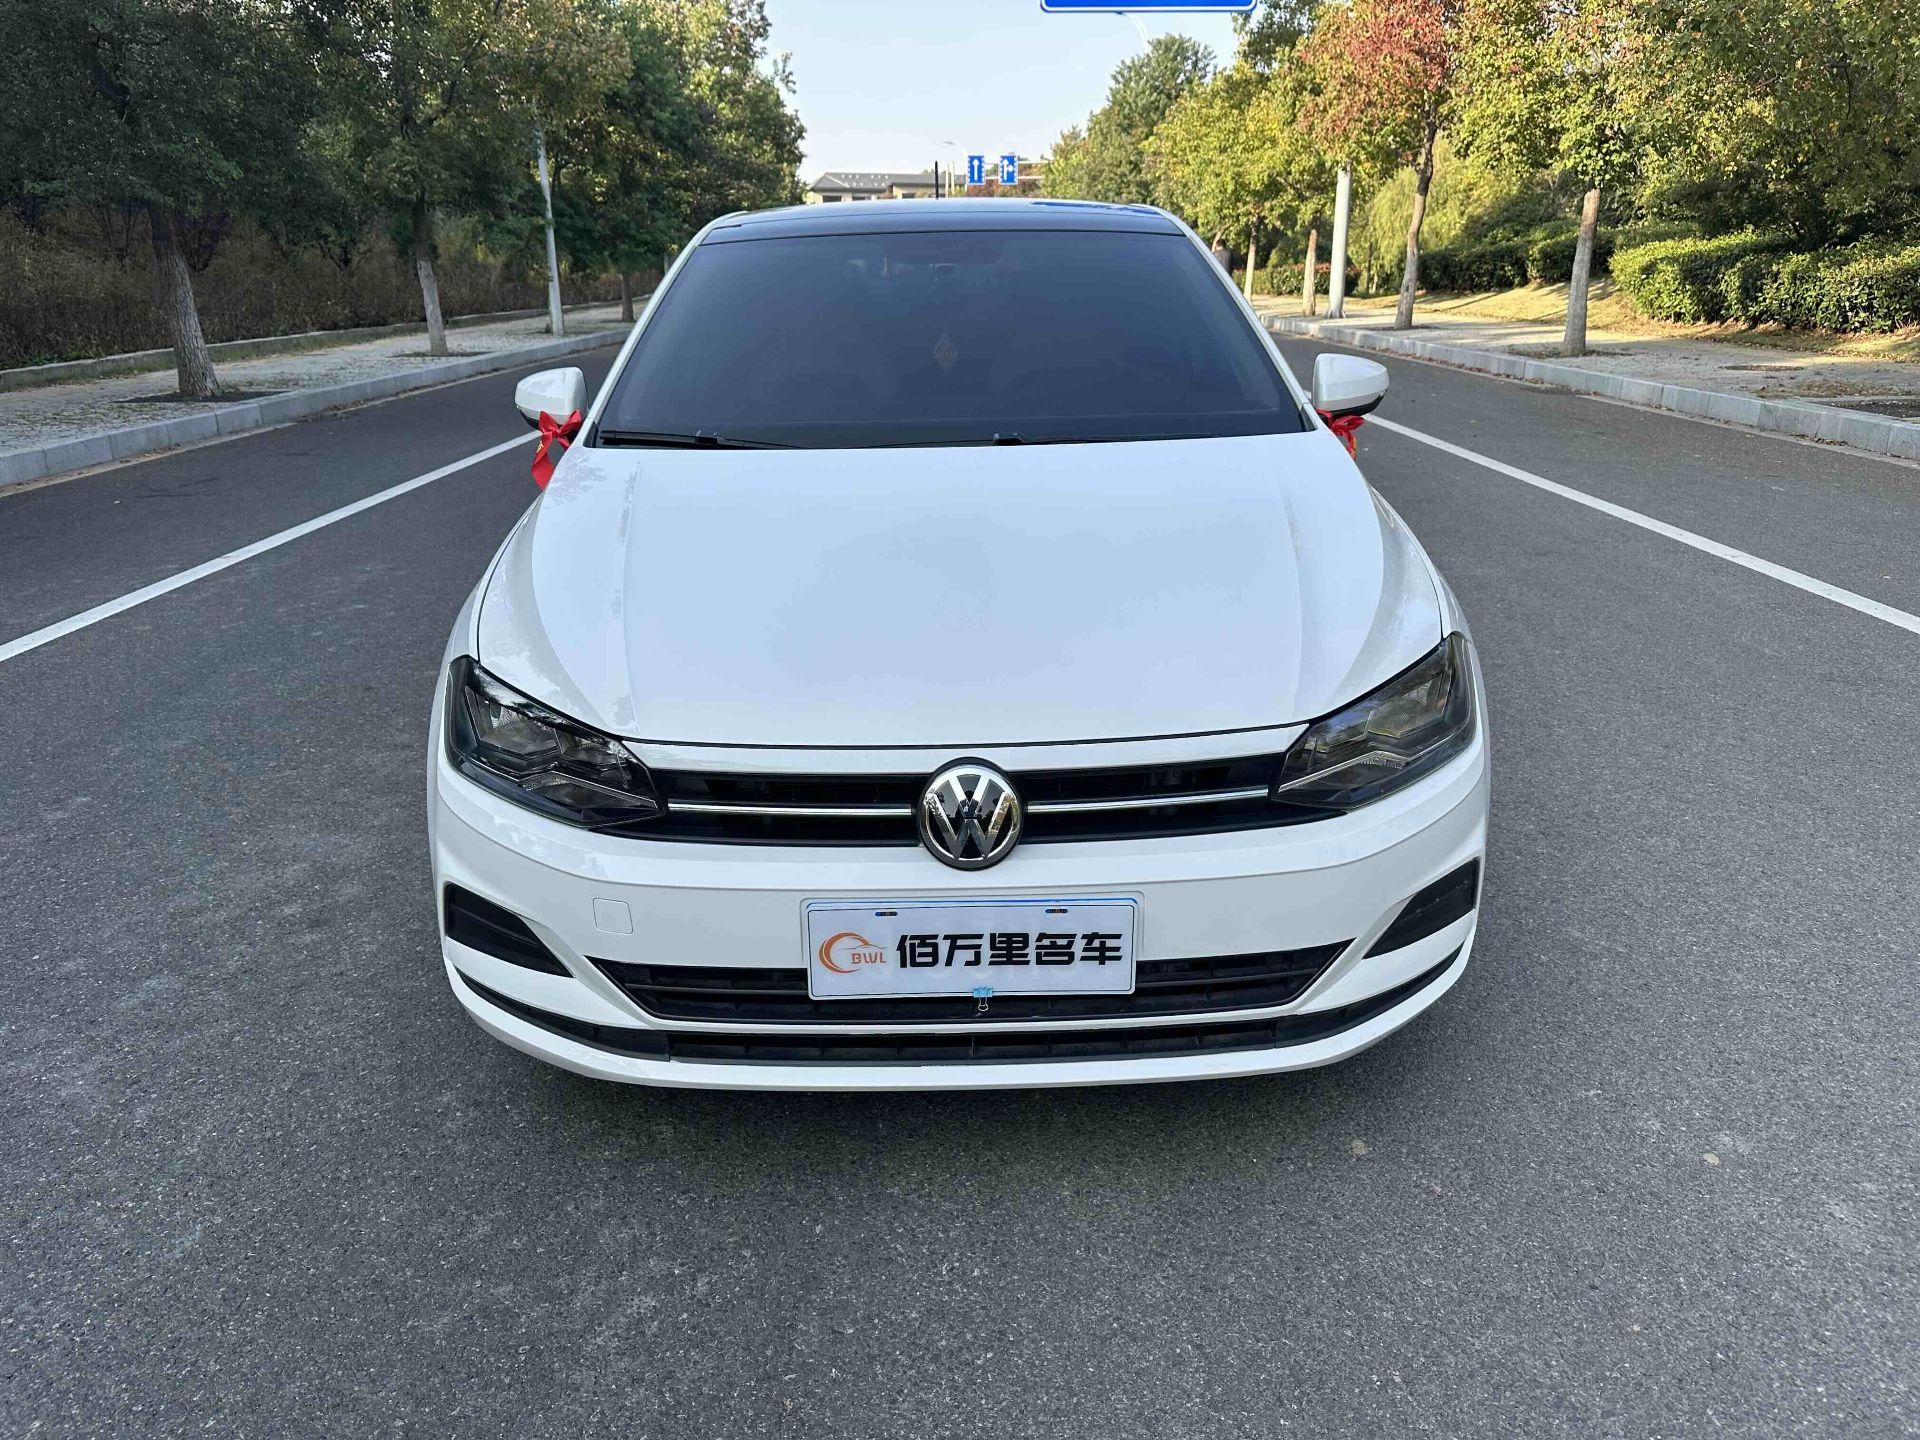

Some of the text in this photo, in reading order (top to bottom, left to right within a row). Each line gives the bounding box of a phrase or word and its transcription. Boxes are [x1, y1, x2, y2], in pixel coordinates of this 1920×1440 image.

[922, 765, 1018, 862] VW
[851, 952, 887, 964] BWL
[896, 932, 1123, 968] 佰万里名车
